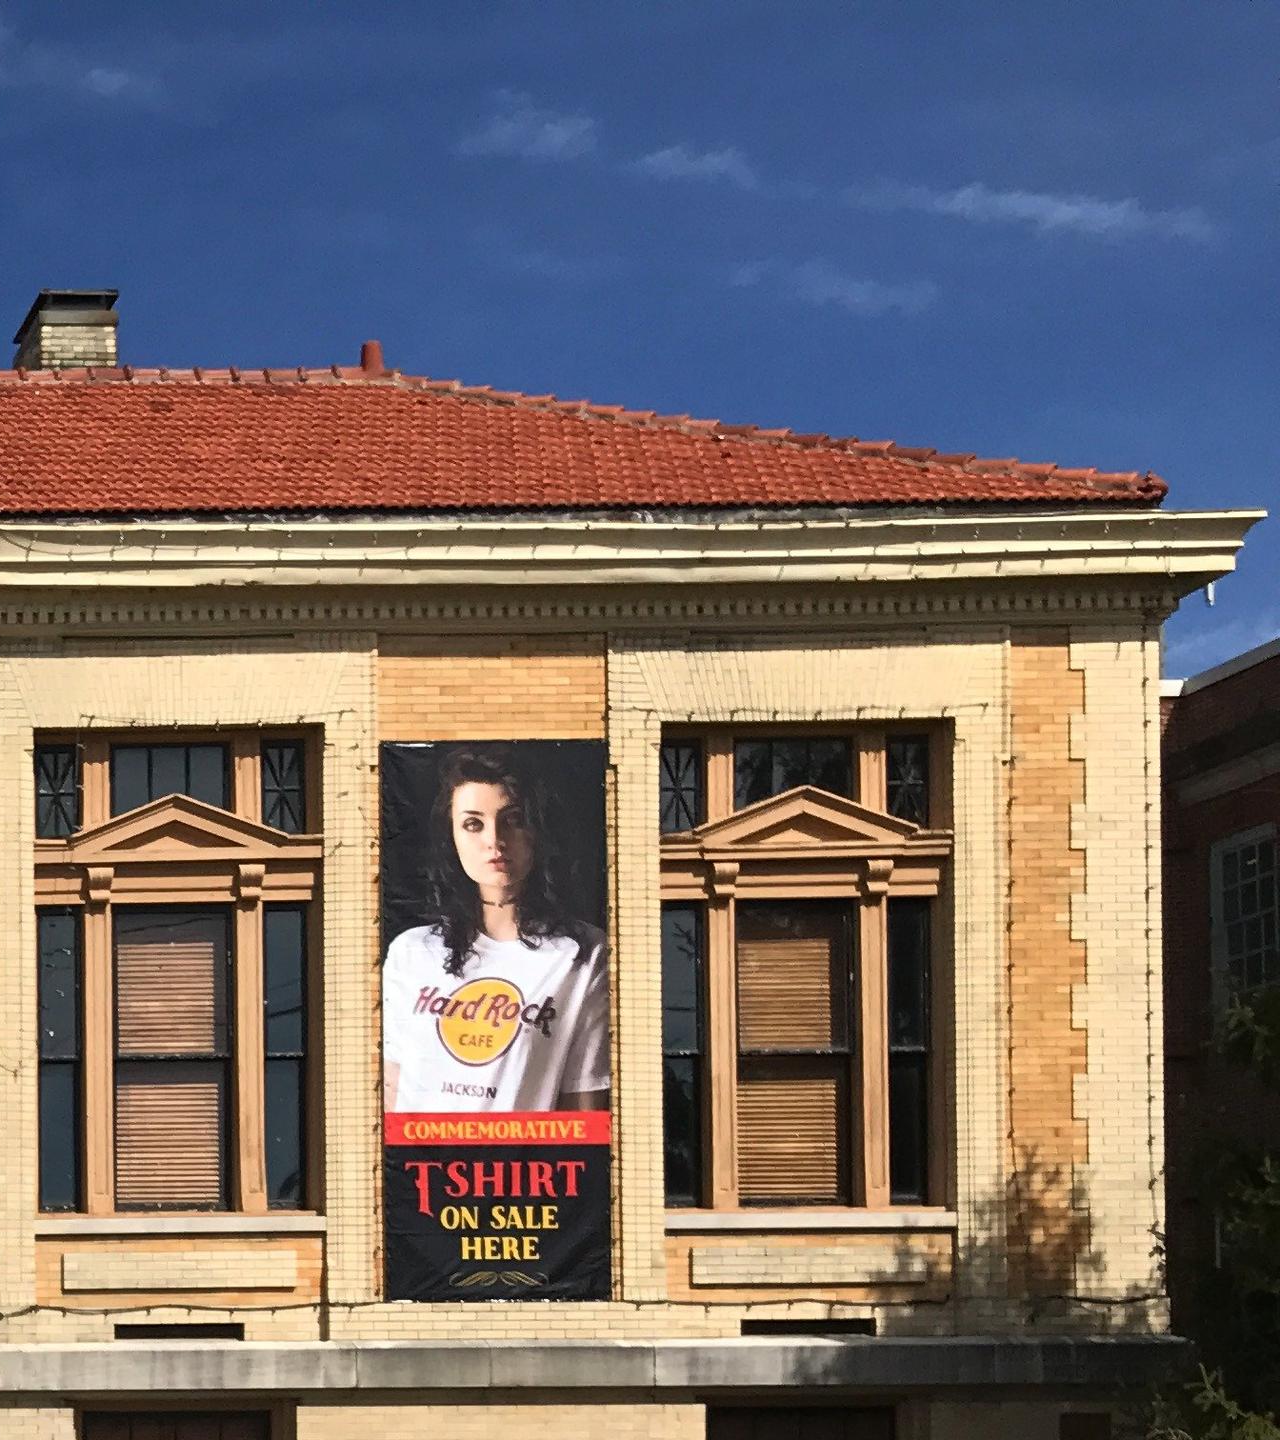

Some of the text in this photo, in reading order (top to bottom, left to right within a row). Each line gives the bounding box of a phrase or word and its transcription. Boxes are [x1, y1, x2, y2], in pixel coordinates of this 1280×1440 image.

[413, 985, 557, 1038] Hard Rock
[458, 1032, 494, 1049] CAFE
[440, 1080, 498, 1100] JACKSON
[403, 1119, 587, 1140] COMMEMORATIVE
[439, 1204, 560, 1230] ON SALE
[460, 1235, 541, 1261] HERE
